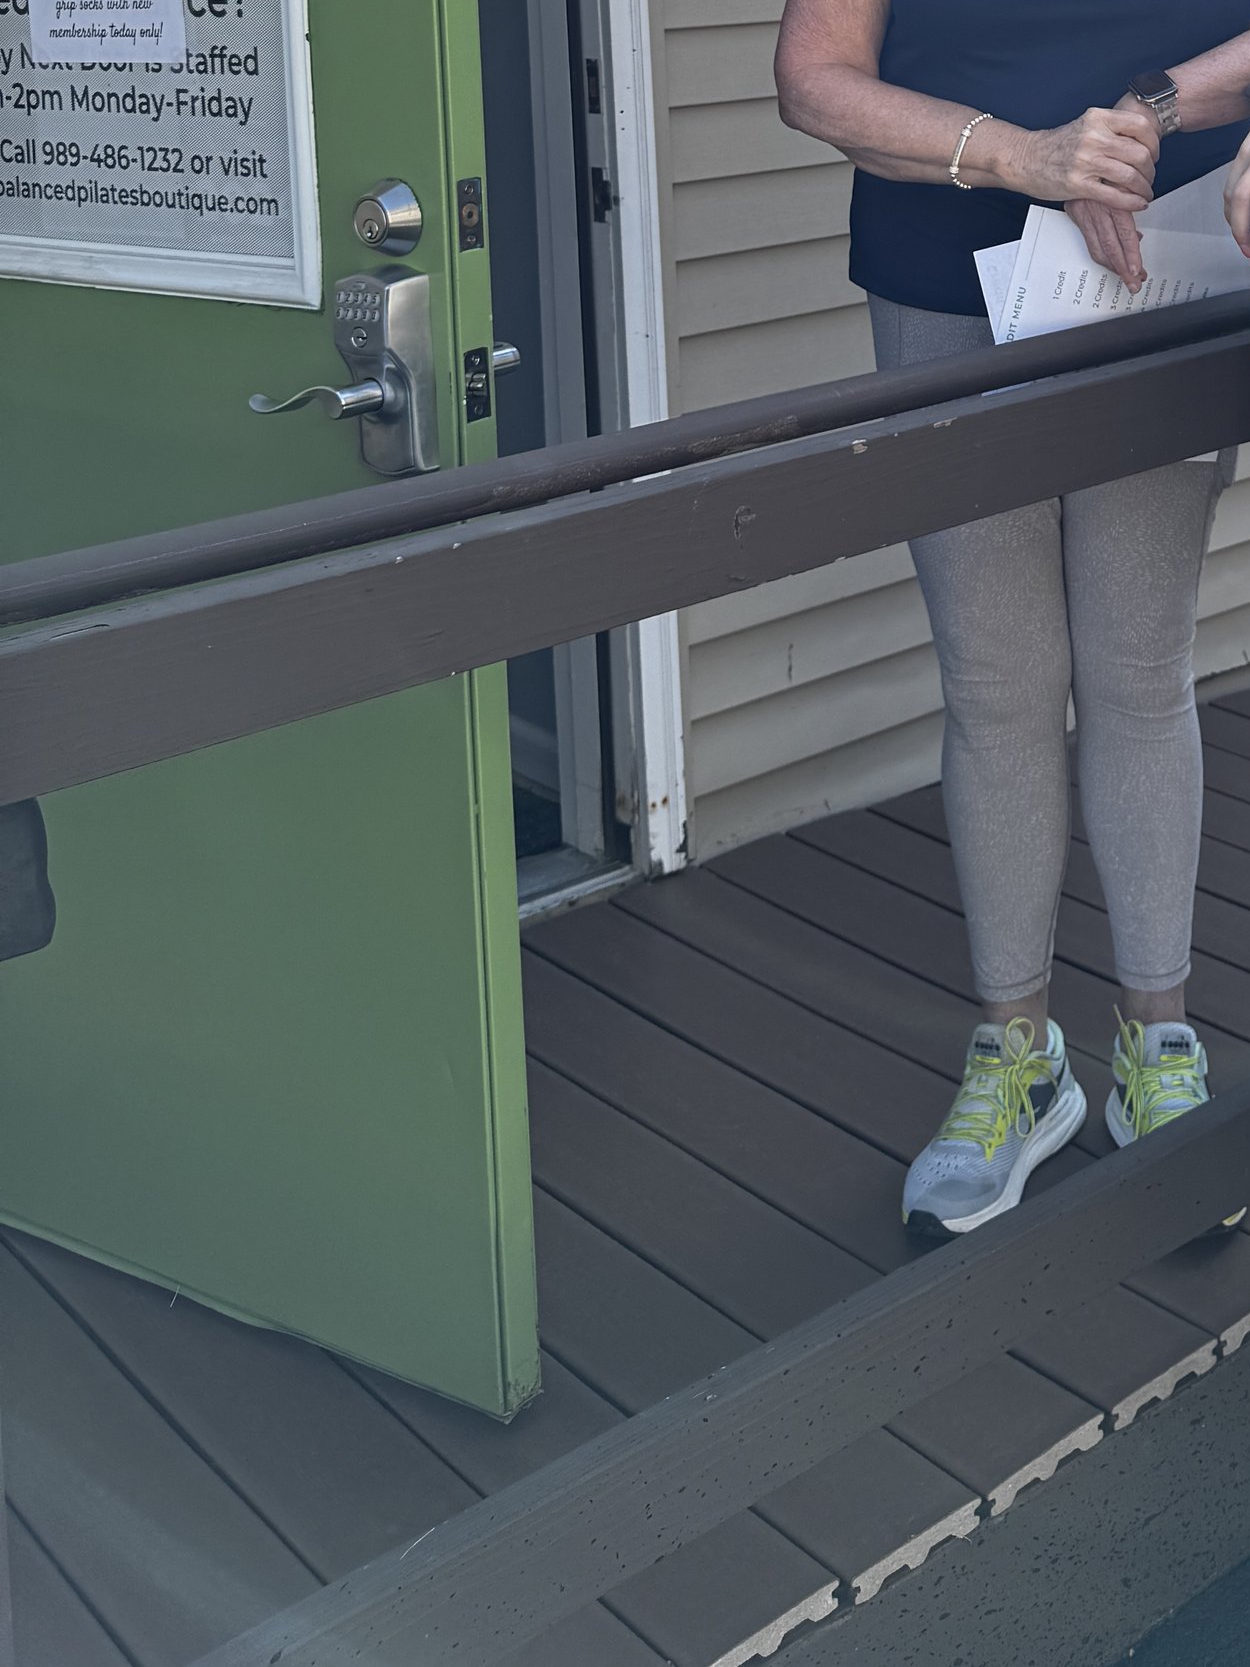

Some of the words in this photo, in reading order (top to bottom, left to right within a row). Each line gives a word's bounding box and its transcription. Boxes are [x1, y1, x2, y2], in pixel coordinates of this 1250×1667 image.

[132, 0, 153, 10] new
[49, 23, 108, 46] membership
[109, 23, 137, 46] today
[140, 22, 163, 46] only!
[0, 82, 63, 116] -2pm
[70, 85, 253, 126] Monday-Friday
[0, 138, 36, 165] Call
[42, 140, 185, 174] 989-486-1232
[190, 155, 214, 175] or
[220, 149, 268, 179] visit
[1054, 271, 1066, 296] Credit
[1075, 270, 1089, 298] Credits
[1094, 273, 1107, 302] Credits
[1142, 278, 1153, 305] Credits
[1012, 286, 1027, 320] MENU
